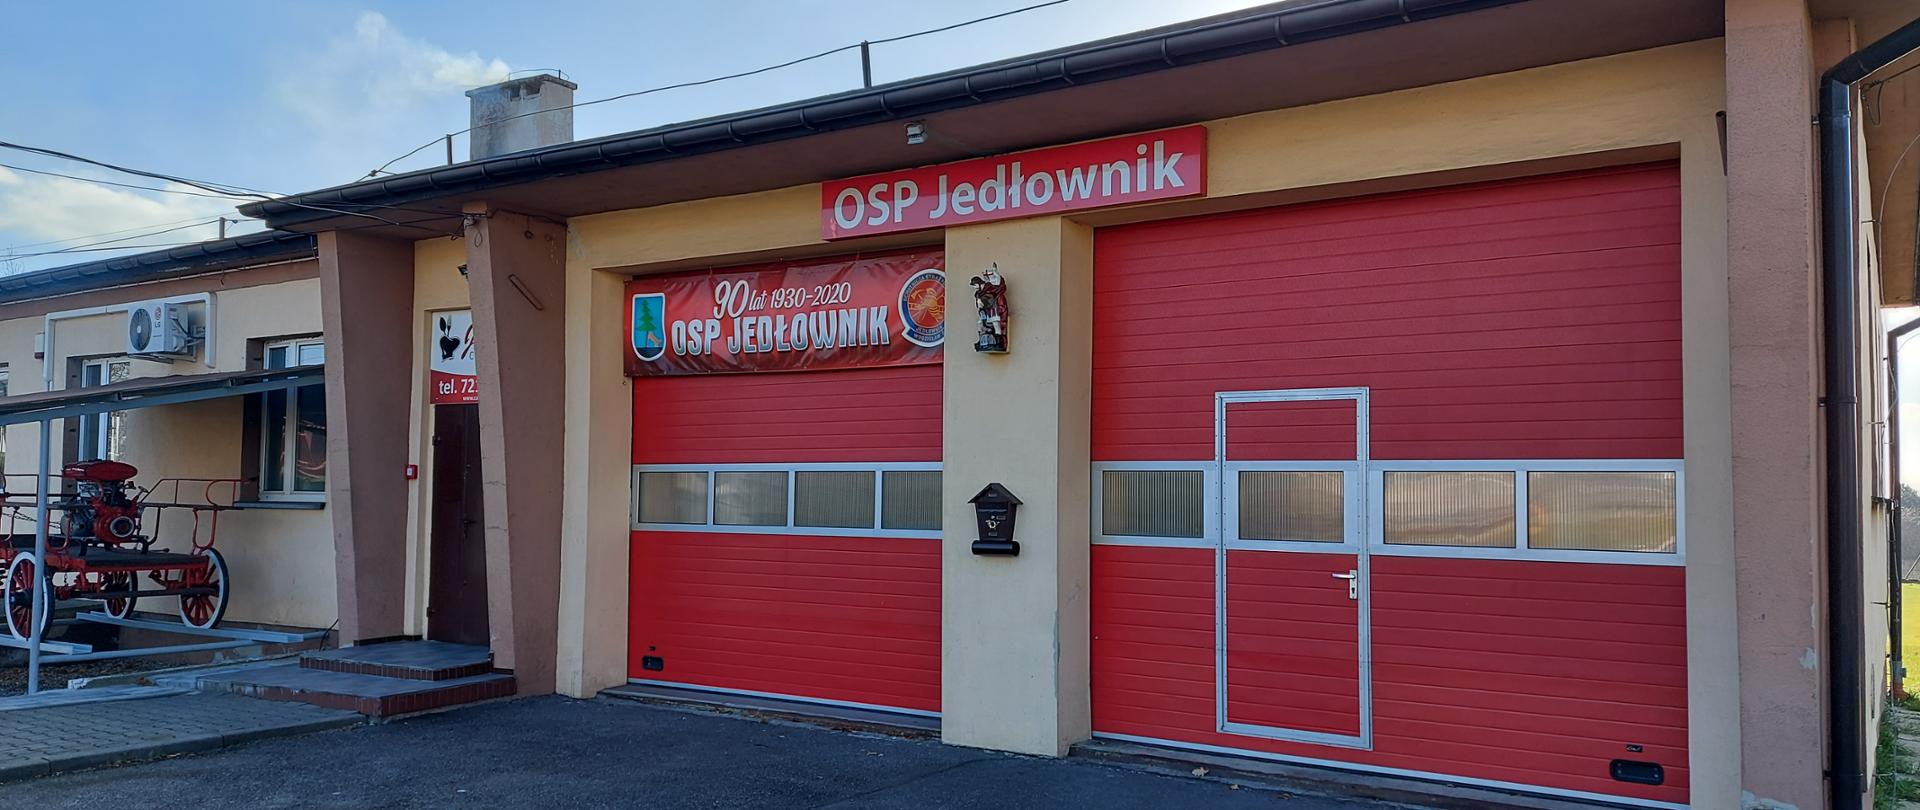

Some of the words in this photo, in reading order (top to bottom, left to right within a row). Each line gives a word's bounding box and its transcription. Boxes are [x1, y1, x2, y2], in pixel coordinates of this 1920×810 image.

[833, 179, 919, 230] OSP
[928, 140, 1185, 220] Jedłownik
[713, 279, 750, 320] 90
[748, 288, 768, 312] lat
[770, 281, 851, 309] 1930-2020
[671, 318, 721, 357] OSP
[727, 305, 890, 356] JEDŁOWNIK
[438, 378, 457, 395] tel.
